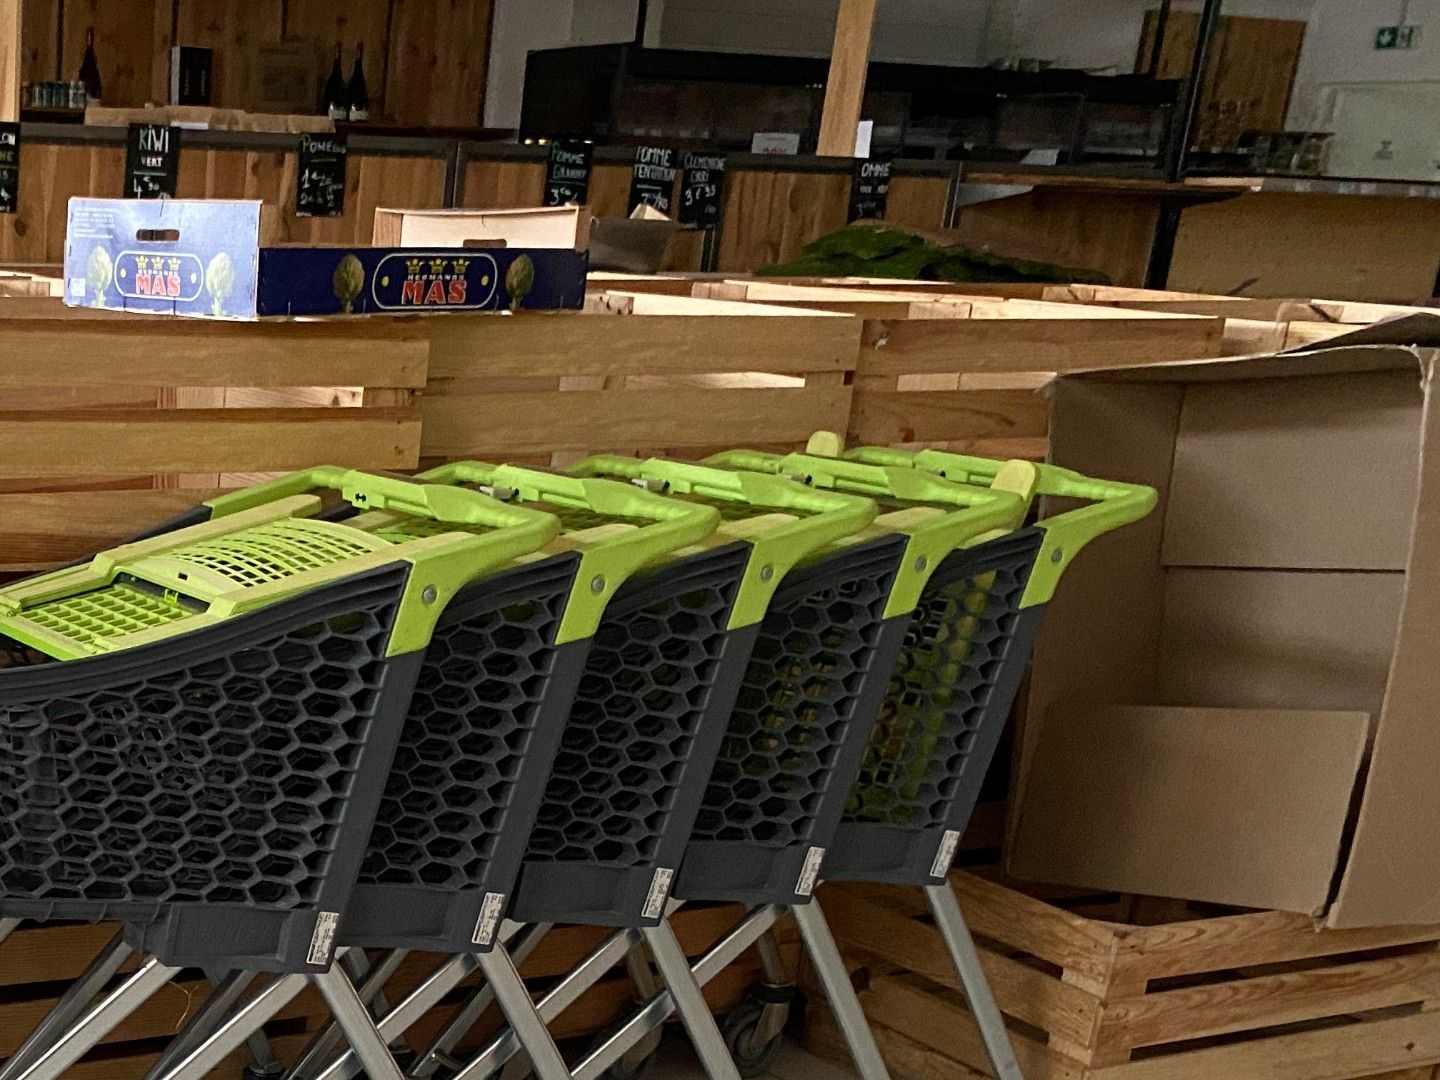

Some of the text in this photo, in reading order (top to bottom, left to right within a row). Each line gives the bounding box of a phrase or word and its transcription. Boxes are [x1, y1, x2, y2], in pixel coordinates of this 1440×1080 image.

[139, 124, 169, 153] KIWI
[140, 156, 163, 168] VERT
[636, 145, 672, 167] POMME
[135, 273, 181, 297] MAS
[401, 279, 468, 305] MAS
